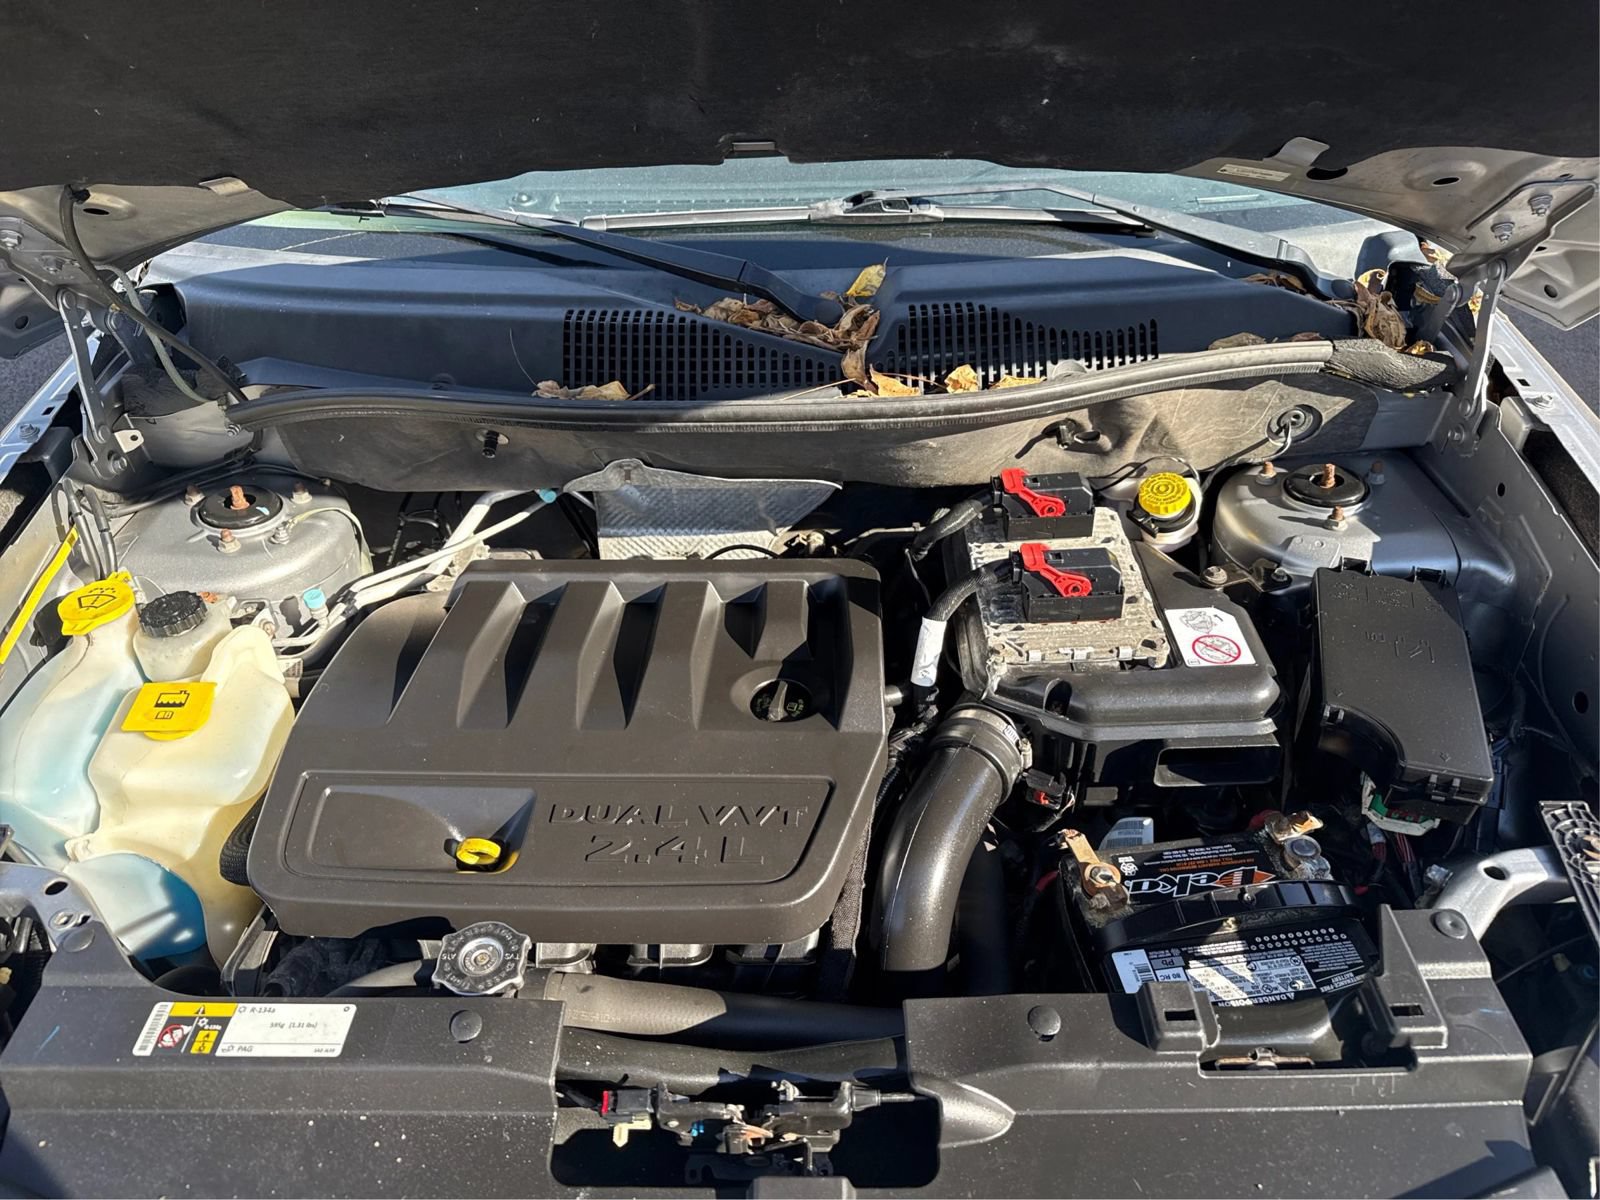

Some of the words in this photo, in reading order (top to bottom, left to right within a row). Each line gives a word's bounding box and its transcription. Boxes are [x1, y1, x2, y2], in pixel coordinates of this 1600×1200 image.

[549, 804, 688, 826] DUAL
[698, 804, 809, 826] VVT
[584, 835, 765, 864] 2.4L
[1161, 958, 1175, 967] Pb
[237, 1045, 254, 1053] PAG
